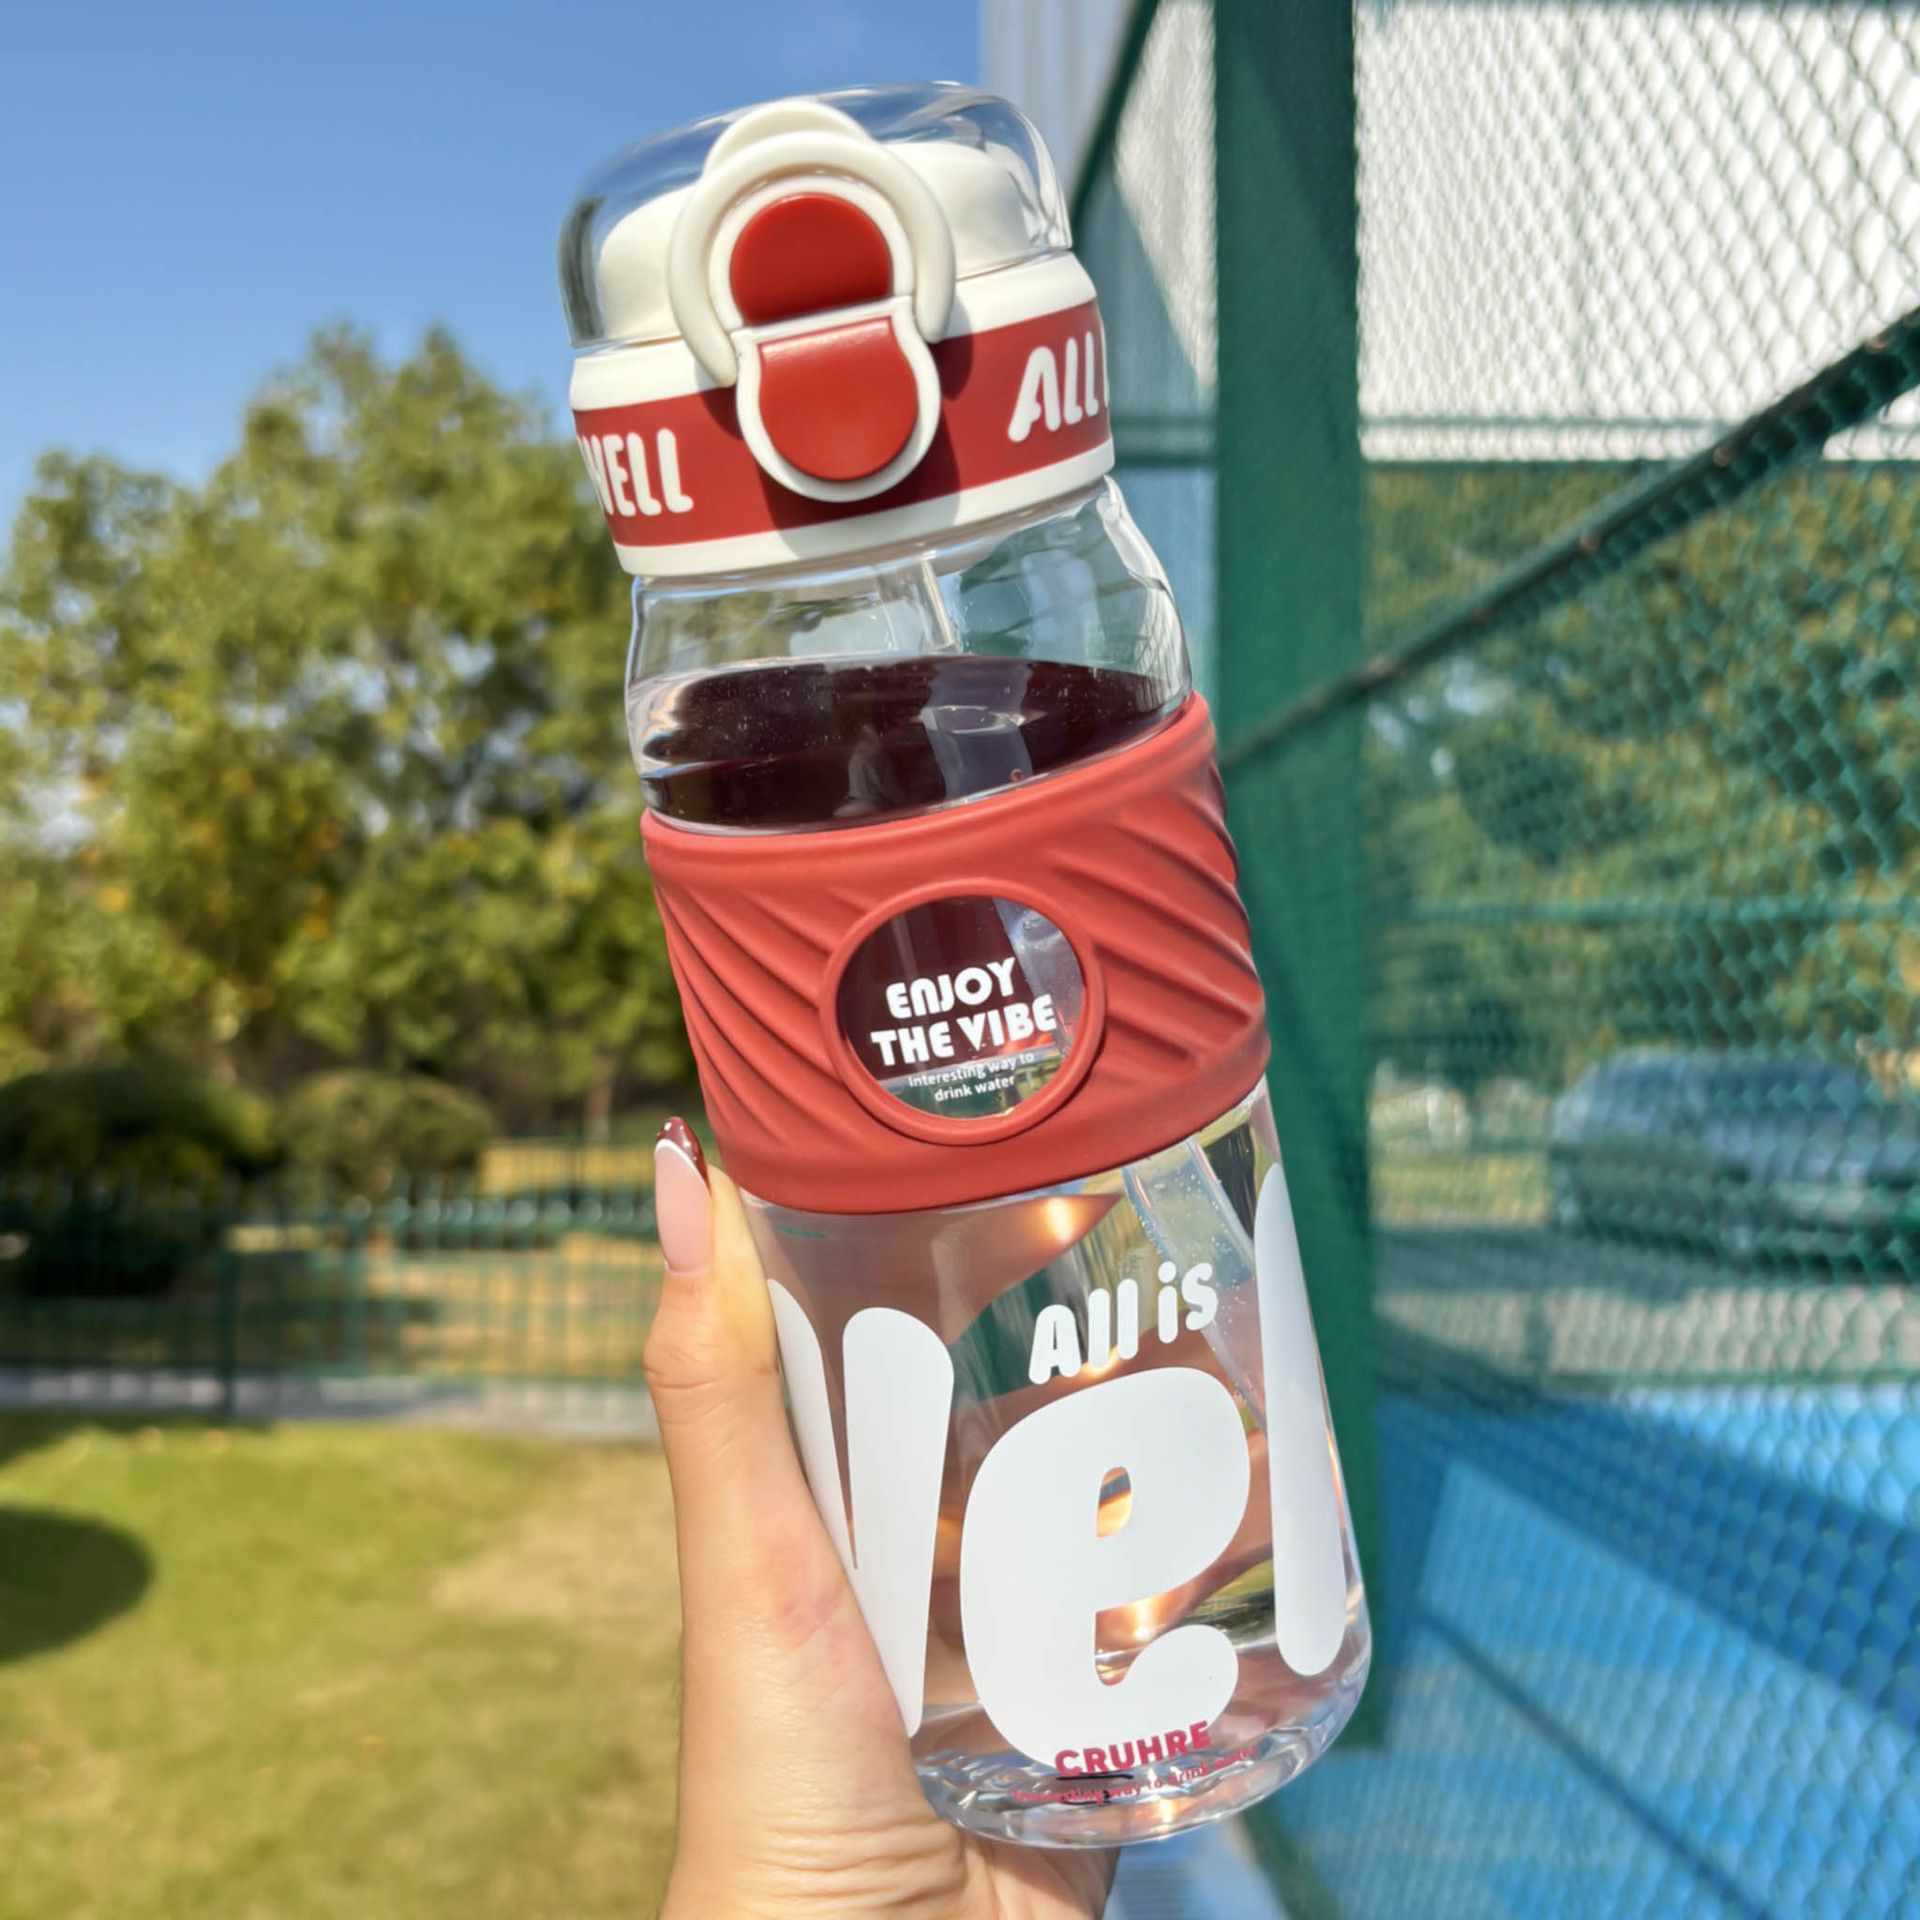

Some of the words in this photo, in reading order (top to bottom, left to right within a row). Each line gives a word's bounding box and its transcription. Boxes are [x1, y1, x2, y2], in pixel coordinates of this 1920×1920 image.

[1007, 330, 1100, 443] ALL
[885, 956, 1016, 1019] ENJOY
[870, 1020, 955, 1066] THE
[956, 994, 1058, 1052] VIBE
[908, 1062, 987, 1088] Interesting
[986, 1056, 1017, 1071] way
[1019, 1052, 1035, 1065] to
[934, 1084, 973, 1102] drink
[974, 1075, 1015, 1095] water
[1028, 1278, 1140, 1385] All
[1054, 1720, 1212, 1777] CRUHRE
